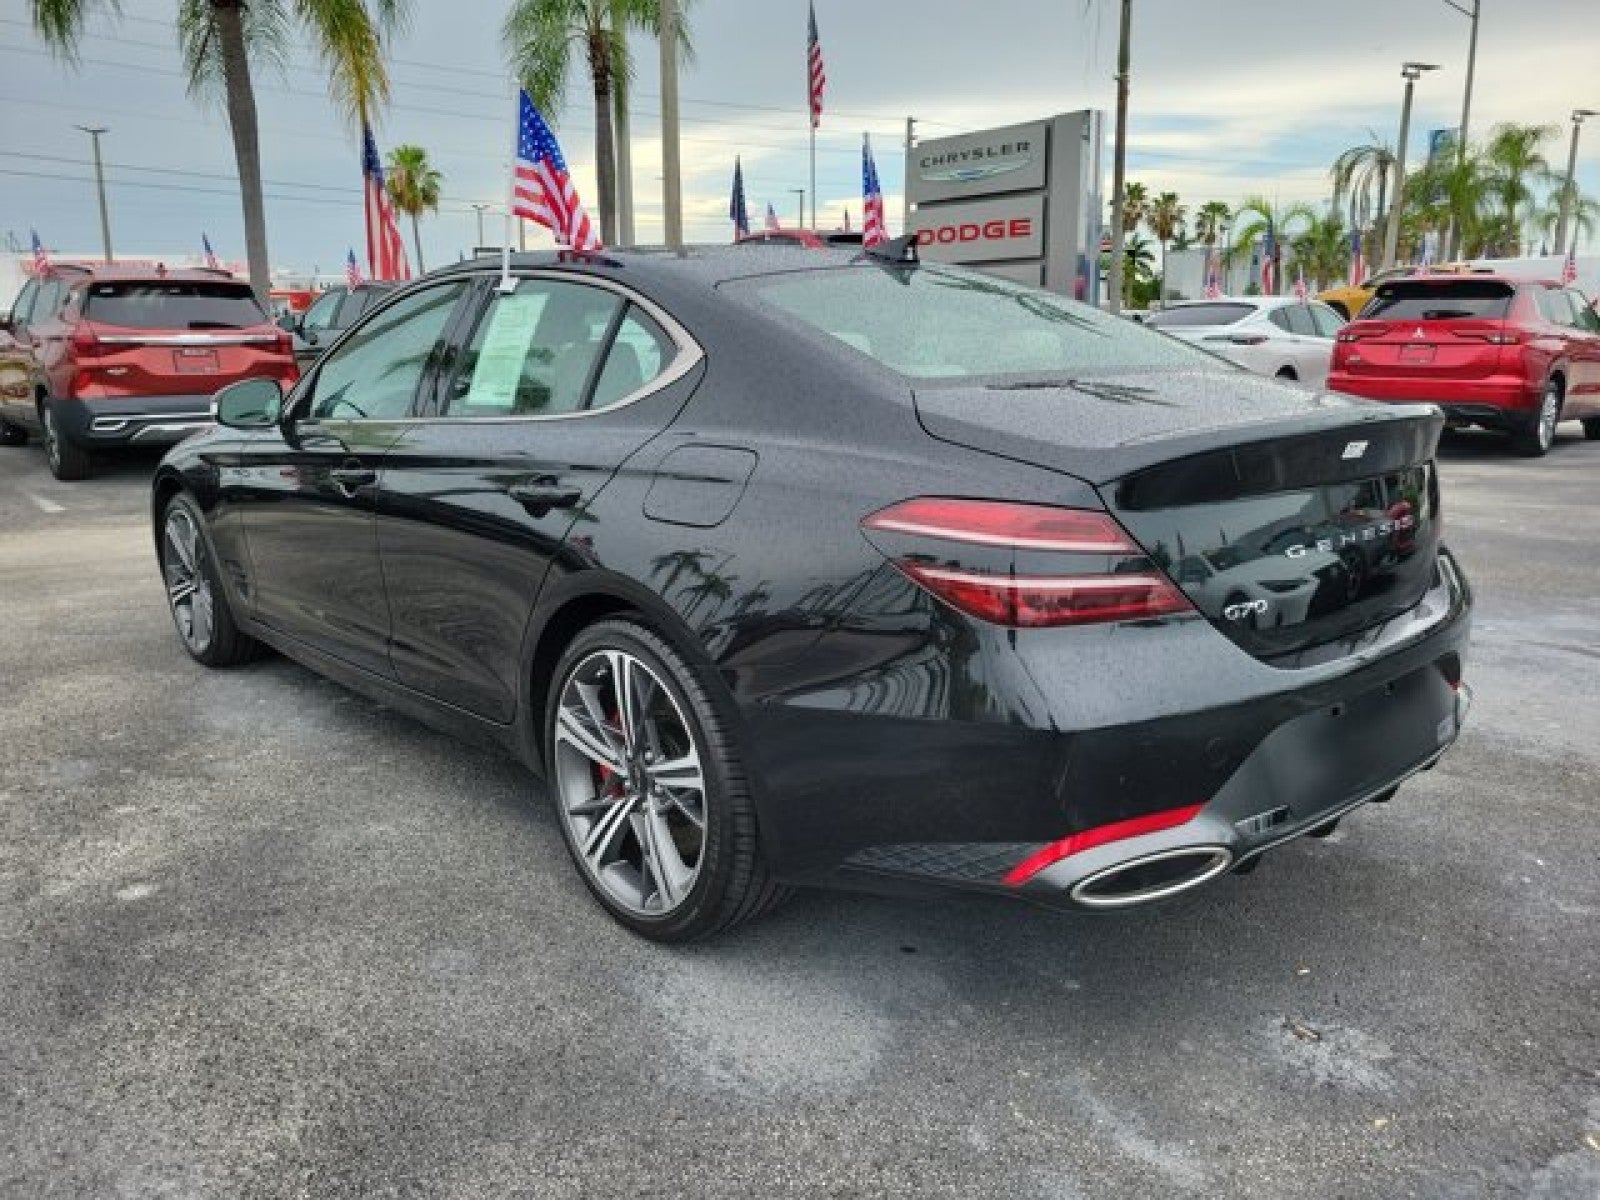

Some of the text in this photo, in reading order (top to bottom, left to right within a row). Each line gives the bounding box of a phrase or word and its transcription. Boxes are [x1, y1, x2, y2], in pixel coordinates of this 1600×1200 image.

[920, 141, 1031, 168] CHRYSLER
[917, 217, 1031, 245] DODGE
[1224, 599, 1269, 621] G70
